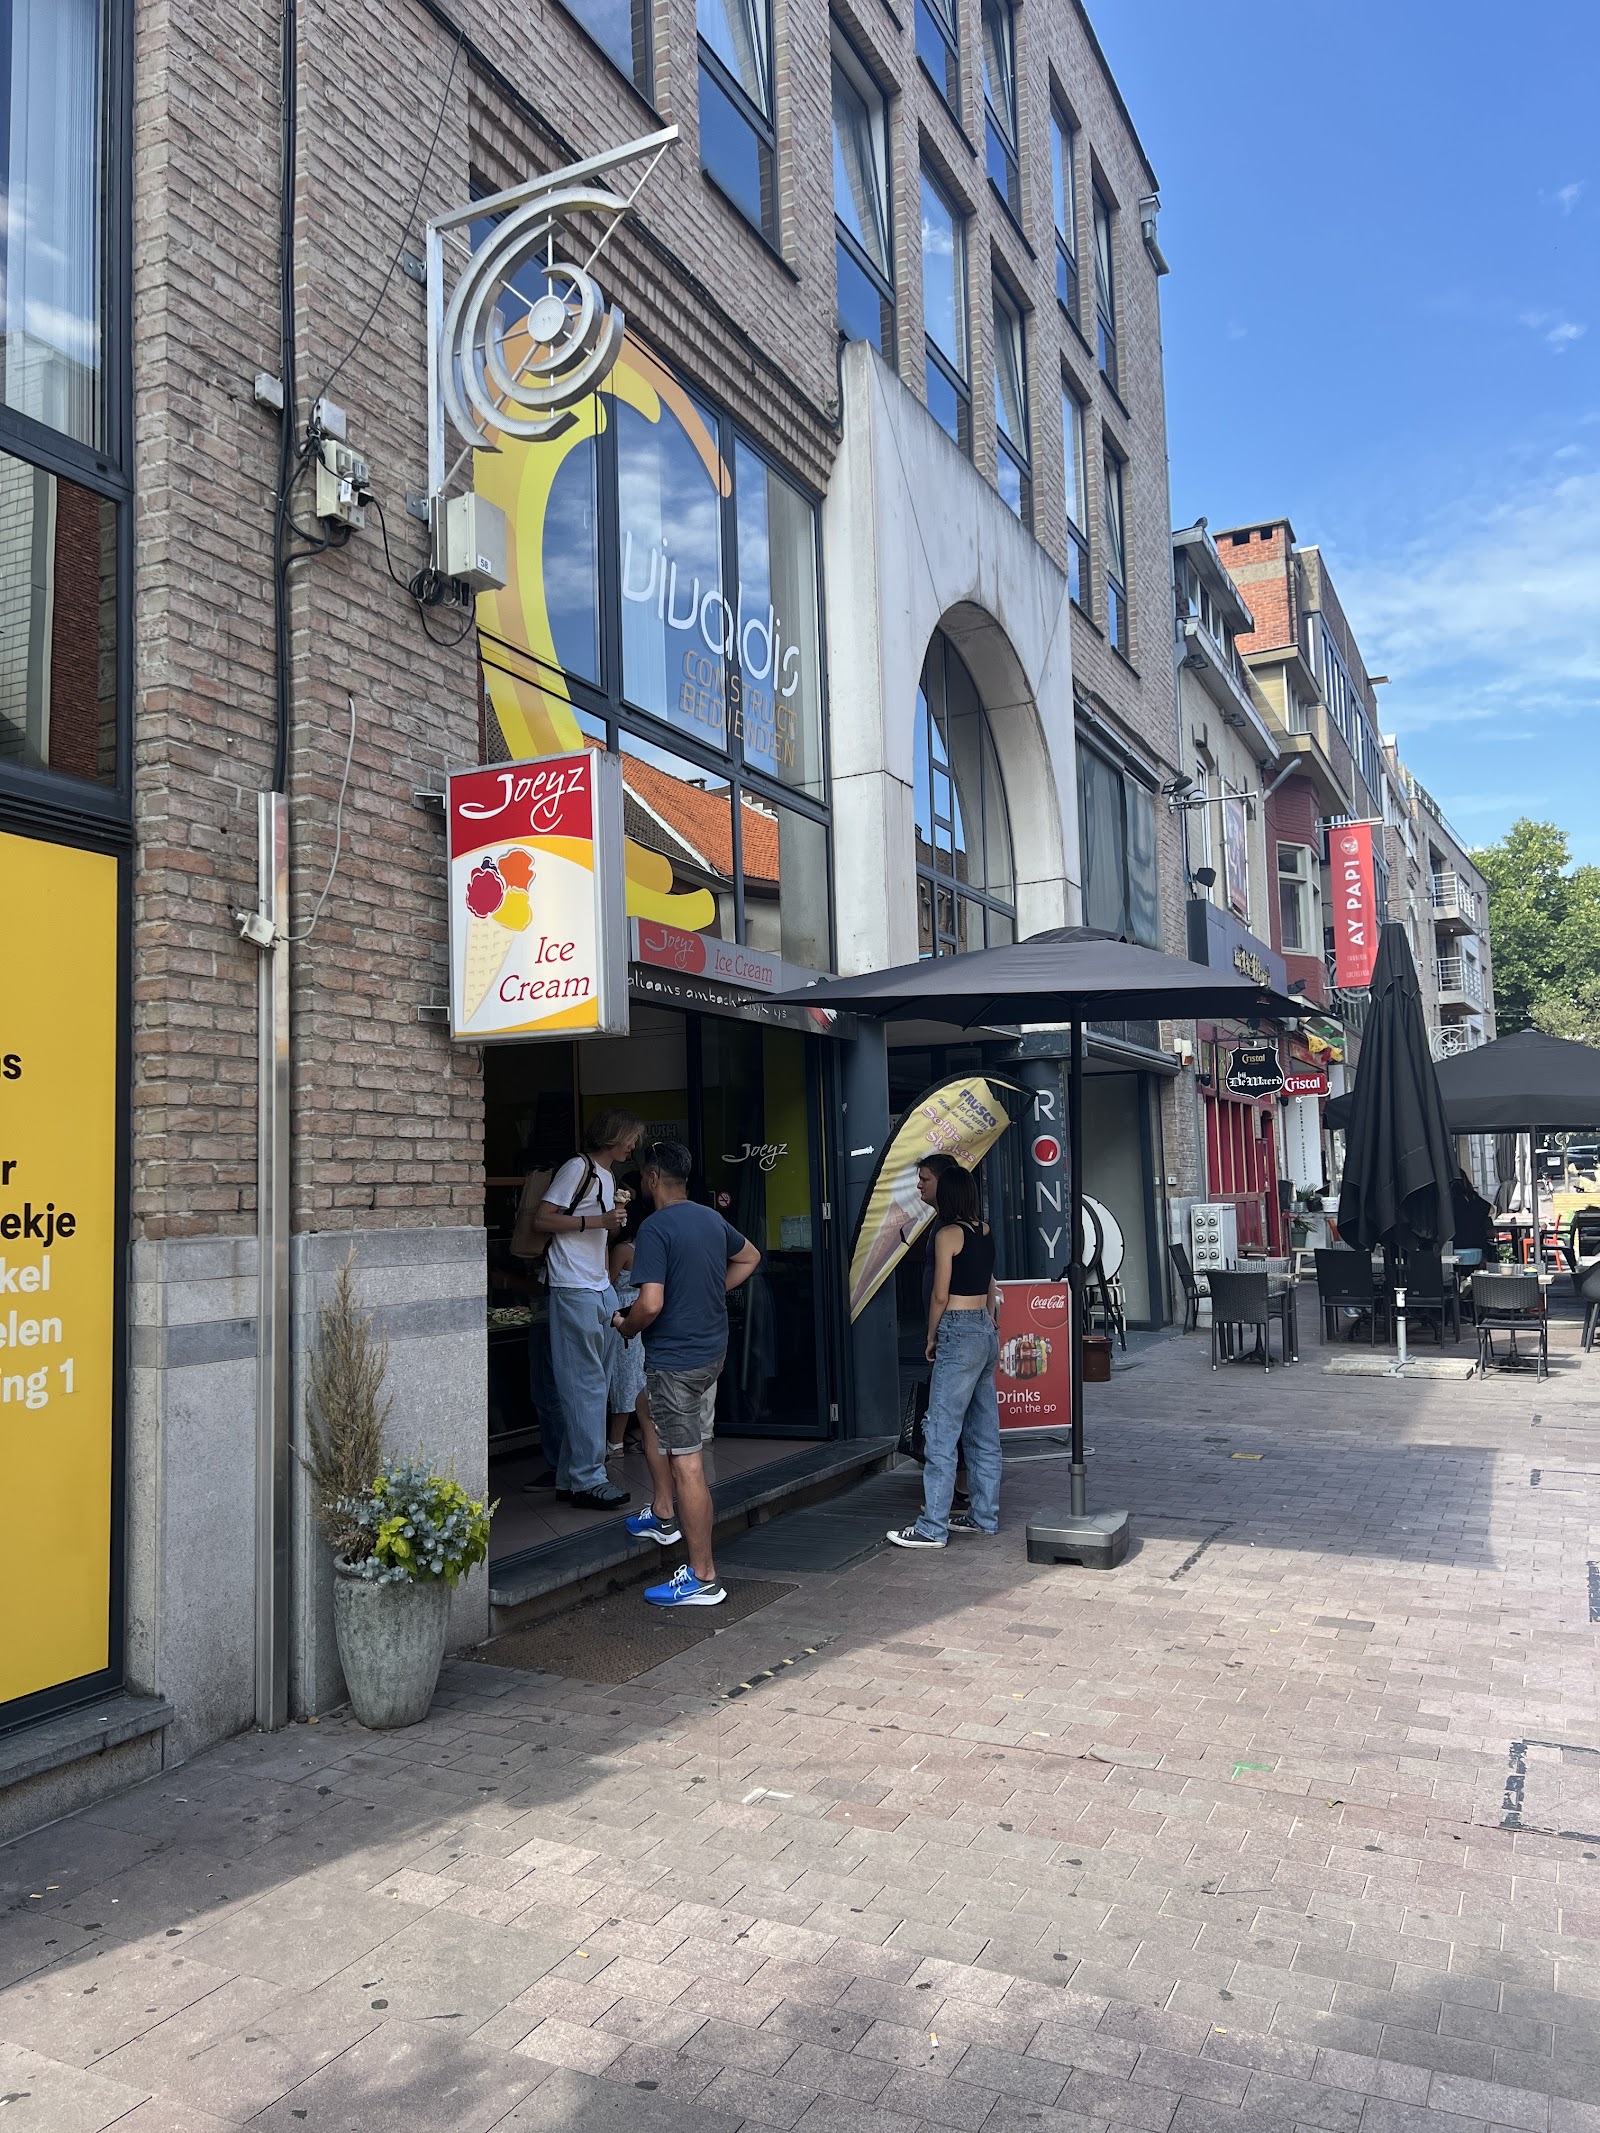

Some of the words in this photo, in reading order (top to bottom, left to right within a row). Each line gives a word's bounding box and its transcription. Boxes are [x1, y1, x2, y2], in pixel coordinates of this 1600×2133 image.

[685, 650, 798, 738] CONSTRUCT
[682, 682, 796, 768] BEDIENDEN
[459, 766, 585, 833] Joeyz
[1343, 860, 1363, 910] PAPI
[535, 936, 575, 964] Ice
[644, 929, 695, 970] Joeyz
[1348, 919, 1365, 946] AY
[715, 949, 733, 973] Ice
[735, 955, 773, 983] Cream
[499, 974, 591, 1003] Cream
[1241, 1054, 1266, 1064] Cristal
[1284, 1077, 1321, 1093] Cristal
[921, 1105, 963, 1142] Softijs
[957, 1102, 967, 1112] Ice
[965, 1109, 989, 1130] Cream
[958, 1088, 997, 1128] FRUSCO
[721, 1143, 788, 1171] Joeyz
[1031, 1089, 1063, 1259] RONY
[0, 1202, 76, 1248] ekje
[0, 1254, 50, 1294] kel
[59, 1357, 74, 1394] 1
[996, 1388, 1041, 1404] Drinks
[1009, 1405, 1022, 1415] on
[1025, 1403, 1041, 1414] the
[1043, 1403, 1057, 1415] go
